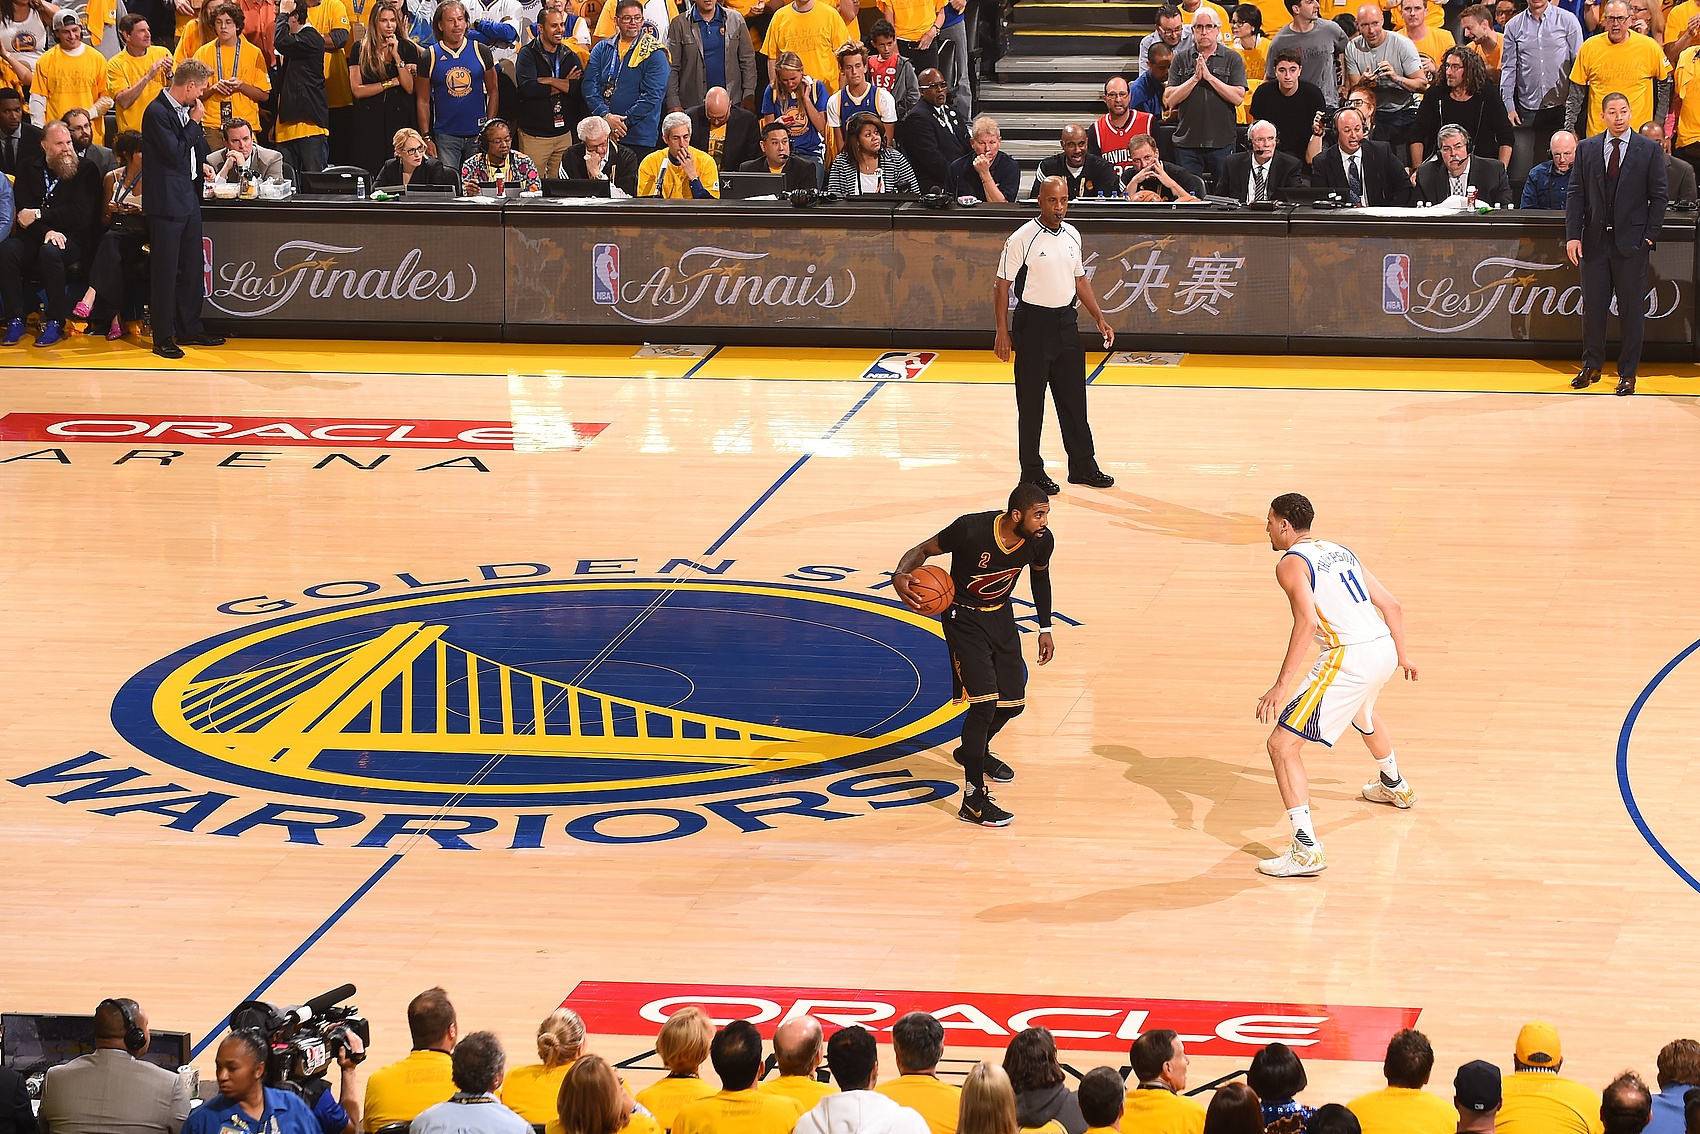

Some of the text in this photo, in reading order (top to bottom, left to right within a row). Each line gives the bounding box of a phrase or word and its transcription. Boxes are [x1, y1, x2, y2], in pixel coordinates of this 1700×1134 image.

[586, 3, 595, 13] 11
[455, 71, 465, 79] 30
[1102, 149, 1133, 164] DAVIDS
[208, 239, 477, 317] Las Finales
[611, 246, 856, 324] As Finais
[596, 291, 612, 301] NBA
[1386, 301, 1402, 311] NBA
[1404, 256, 1681, 334] Les Finas
[46, 419, 542, 444] ORACLE
[0, 448, 491, 473] ARENA
[978, 551, 991, 569] 2
[216, 557, 738, 616] GOLDEN
[1339, 569, 1368, 604] 11
[7, 750, 960, 851] WARRIORS
[639, 995, 1329, 1048] ORACLE
